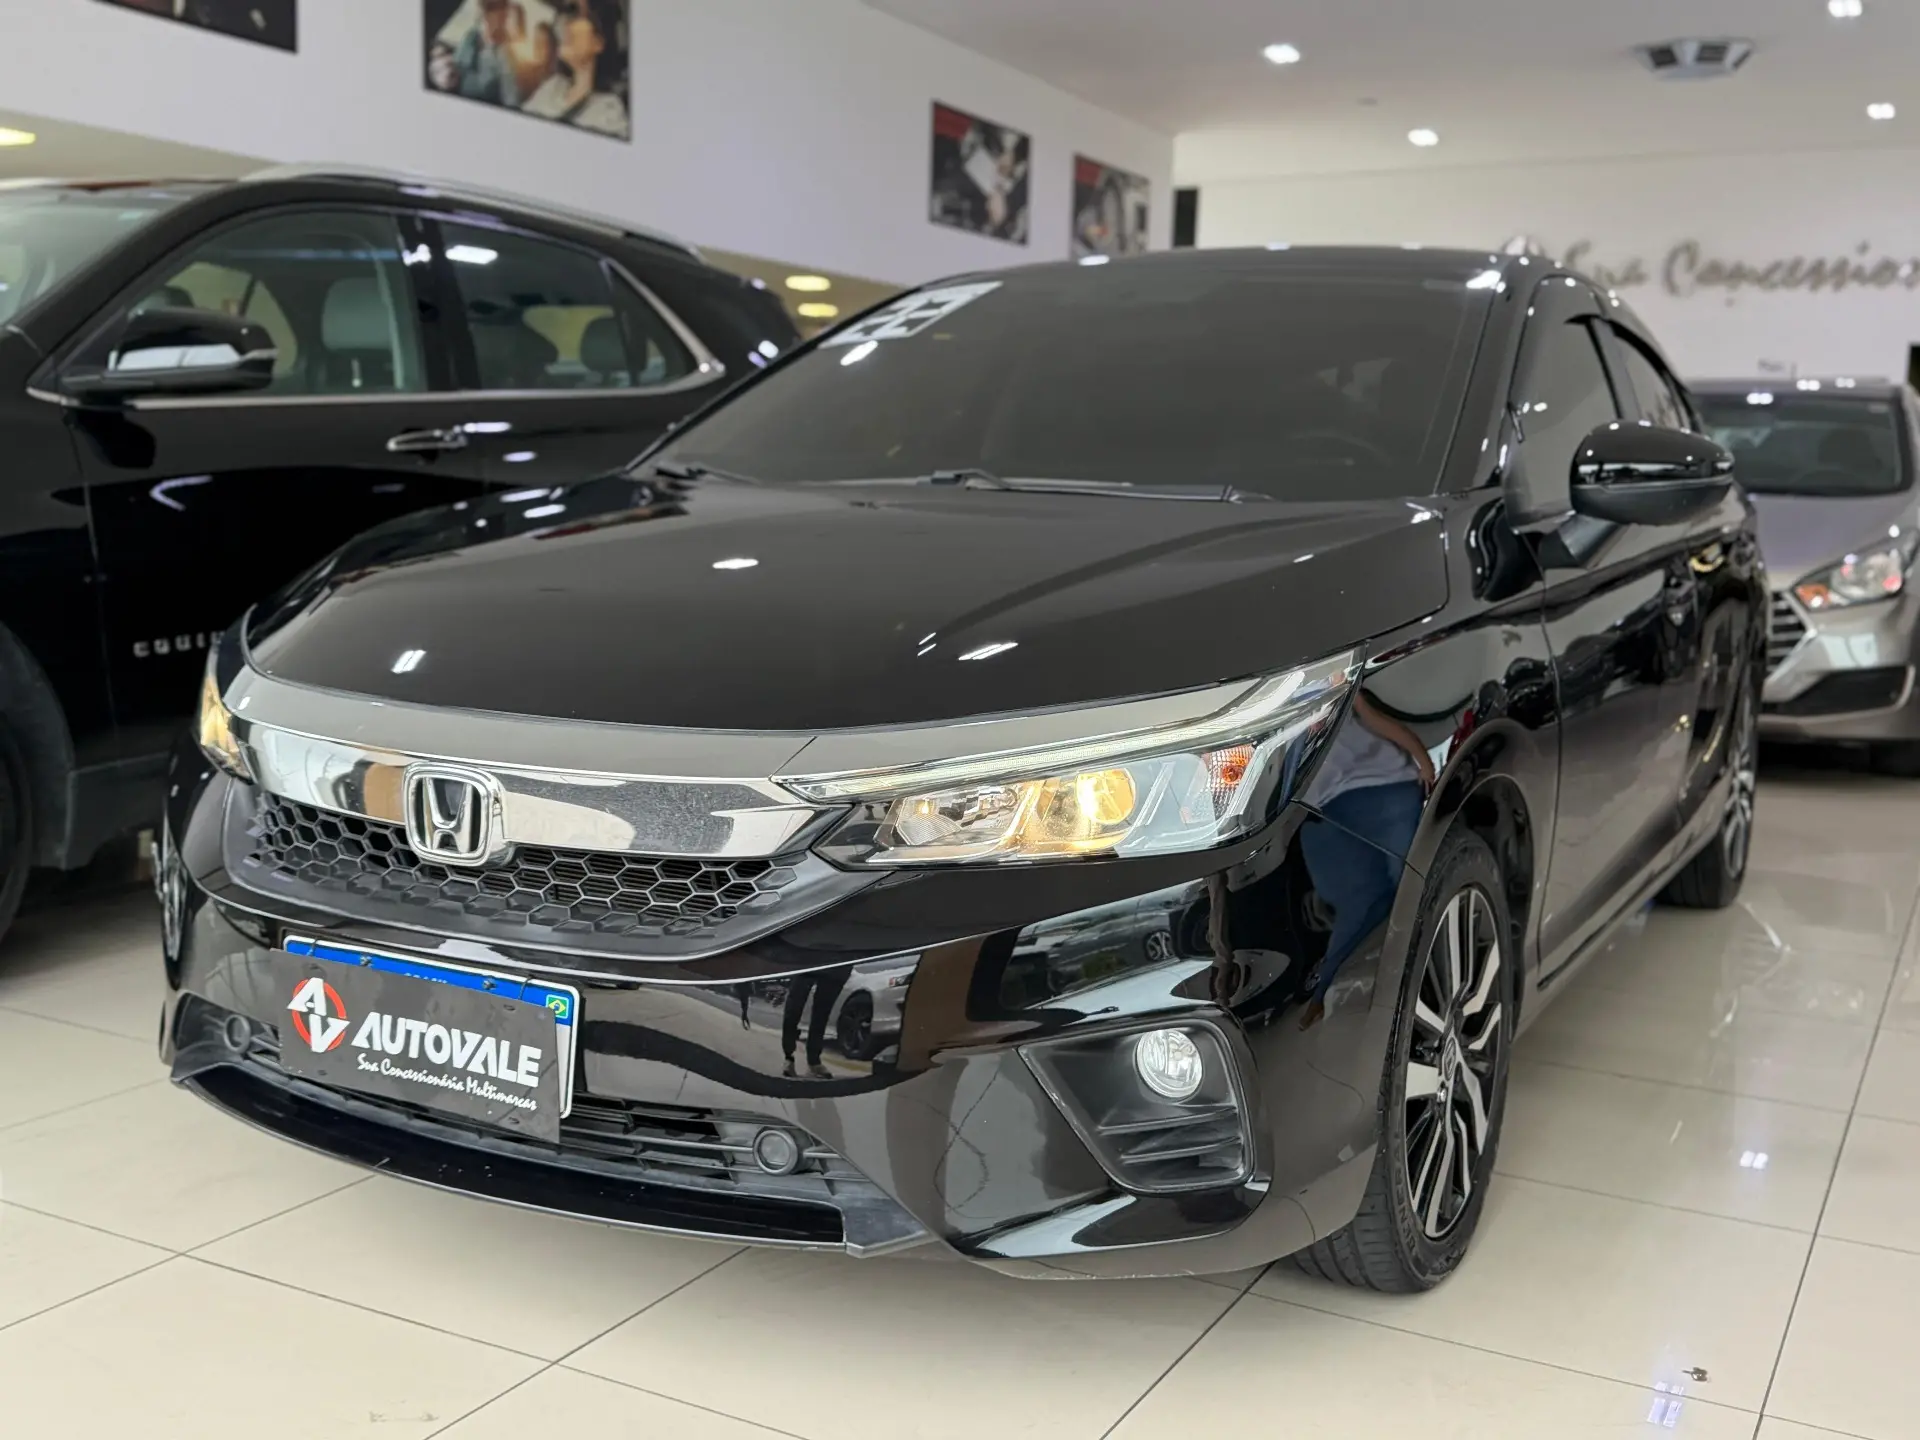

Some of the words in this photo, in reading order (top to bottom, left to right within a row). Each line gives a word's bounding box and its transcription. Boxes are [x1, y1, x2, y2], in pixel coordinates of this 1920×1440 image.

[350, 1011, 542, 1088] AUTOVALE
[357, 1052, 379, 1072] Sua
[466, 1075, 538, 1111] Multimarcas
